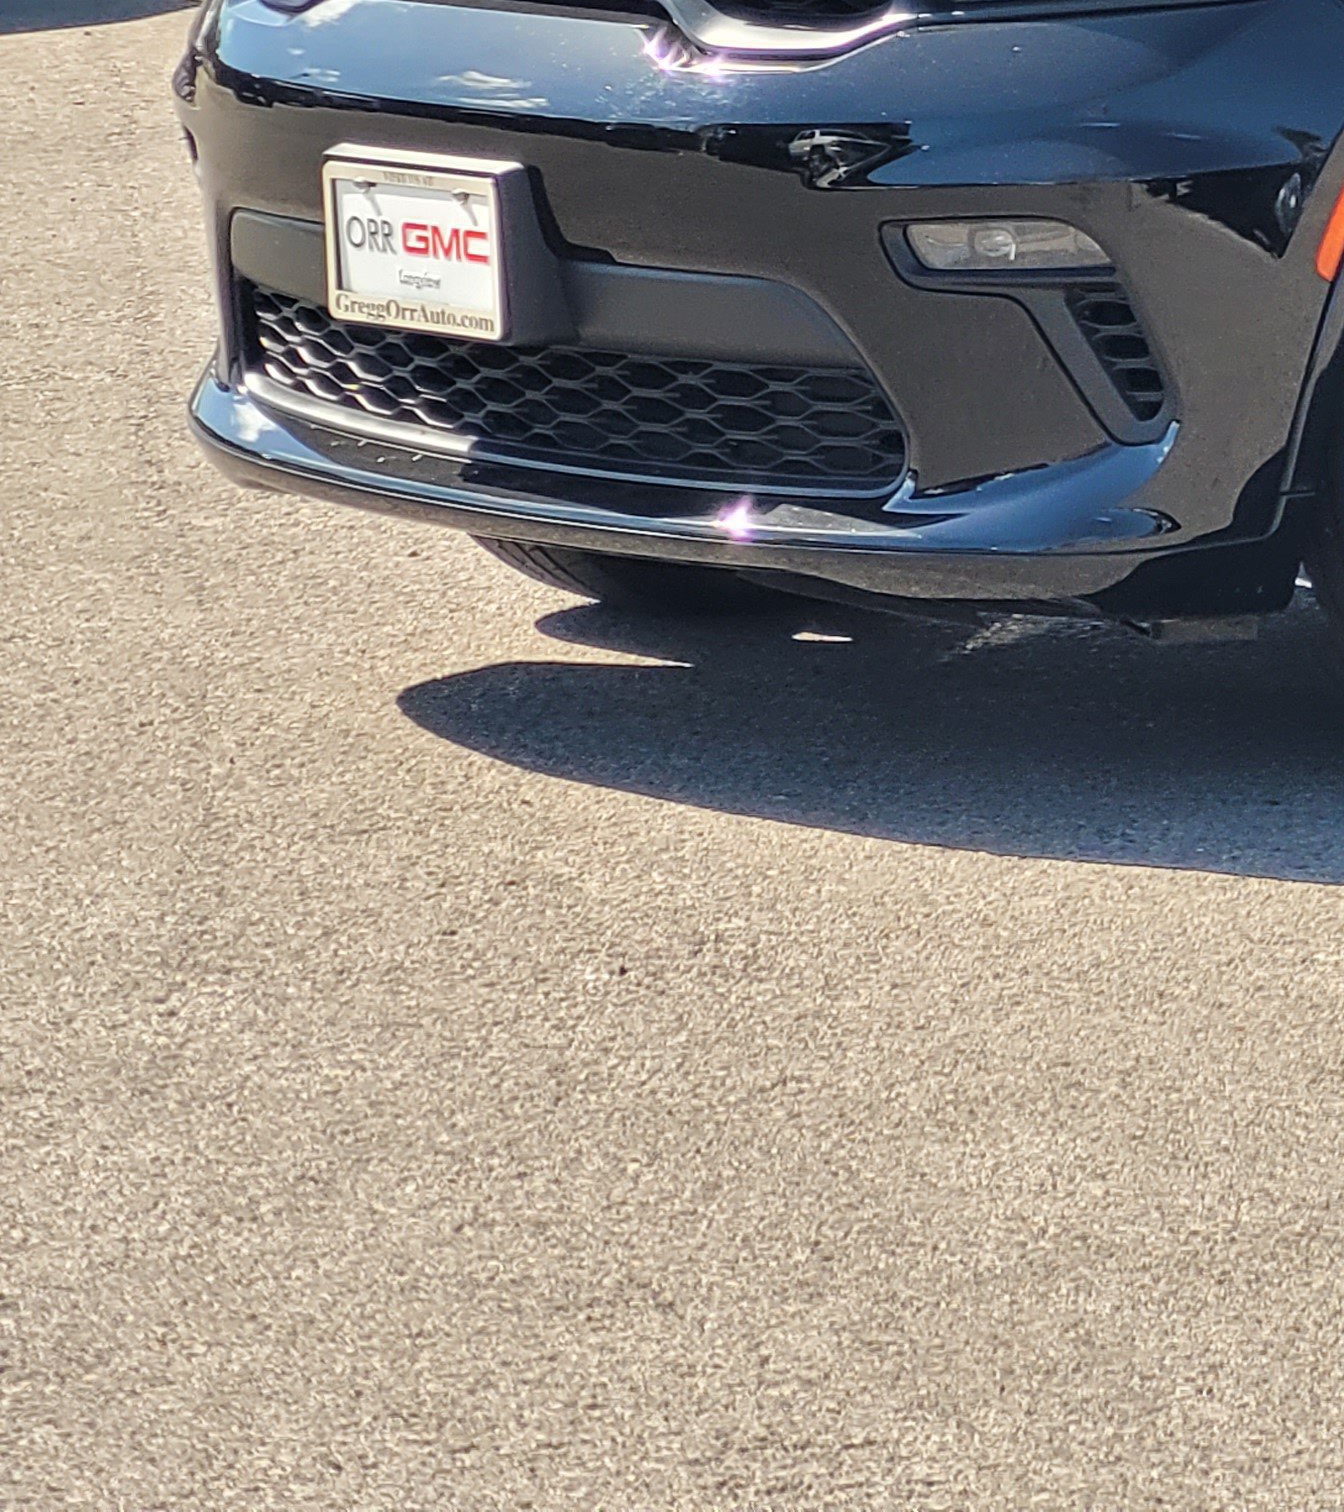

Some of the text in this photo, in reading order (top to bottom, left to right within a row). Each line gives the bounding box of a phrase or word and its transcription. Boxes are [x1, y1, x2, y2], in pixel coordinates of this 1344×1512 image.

[346, 216, 490, 264] ORR GMC
[335, 293, 495, 332] GreggOrrAuto.com
